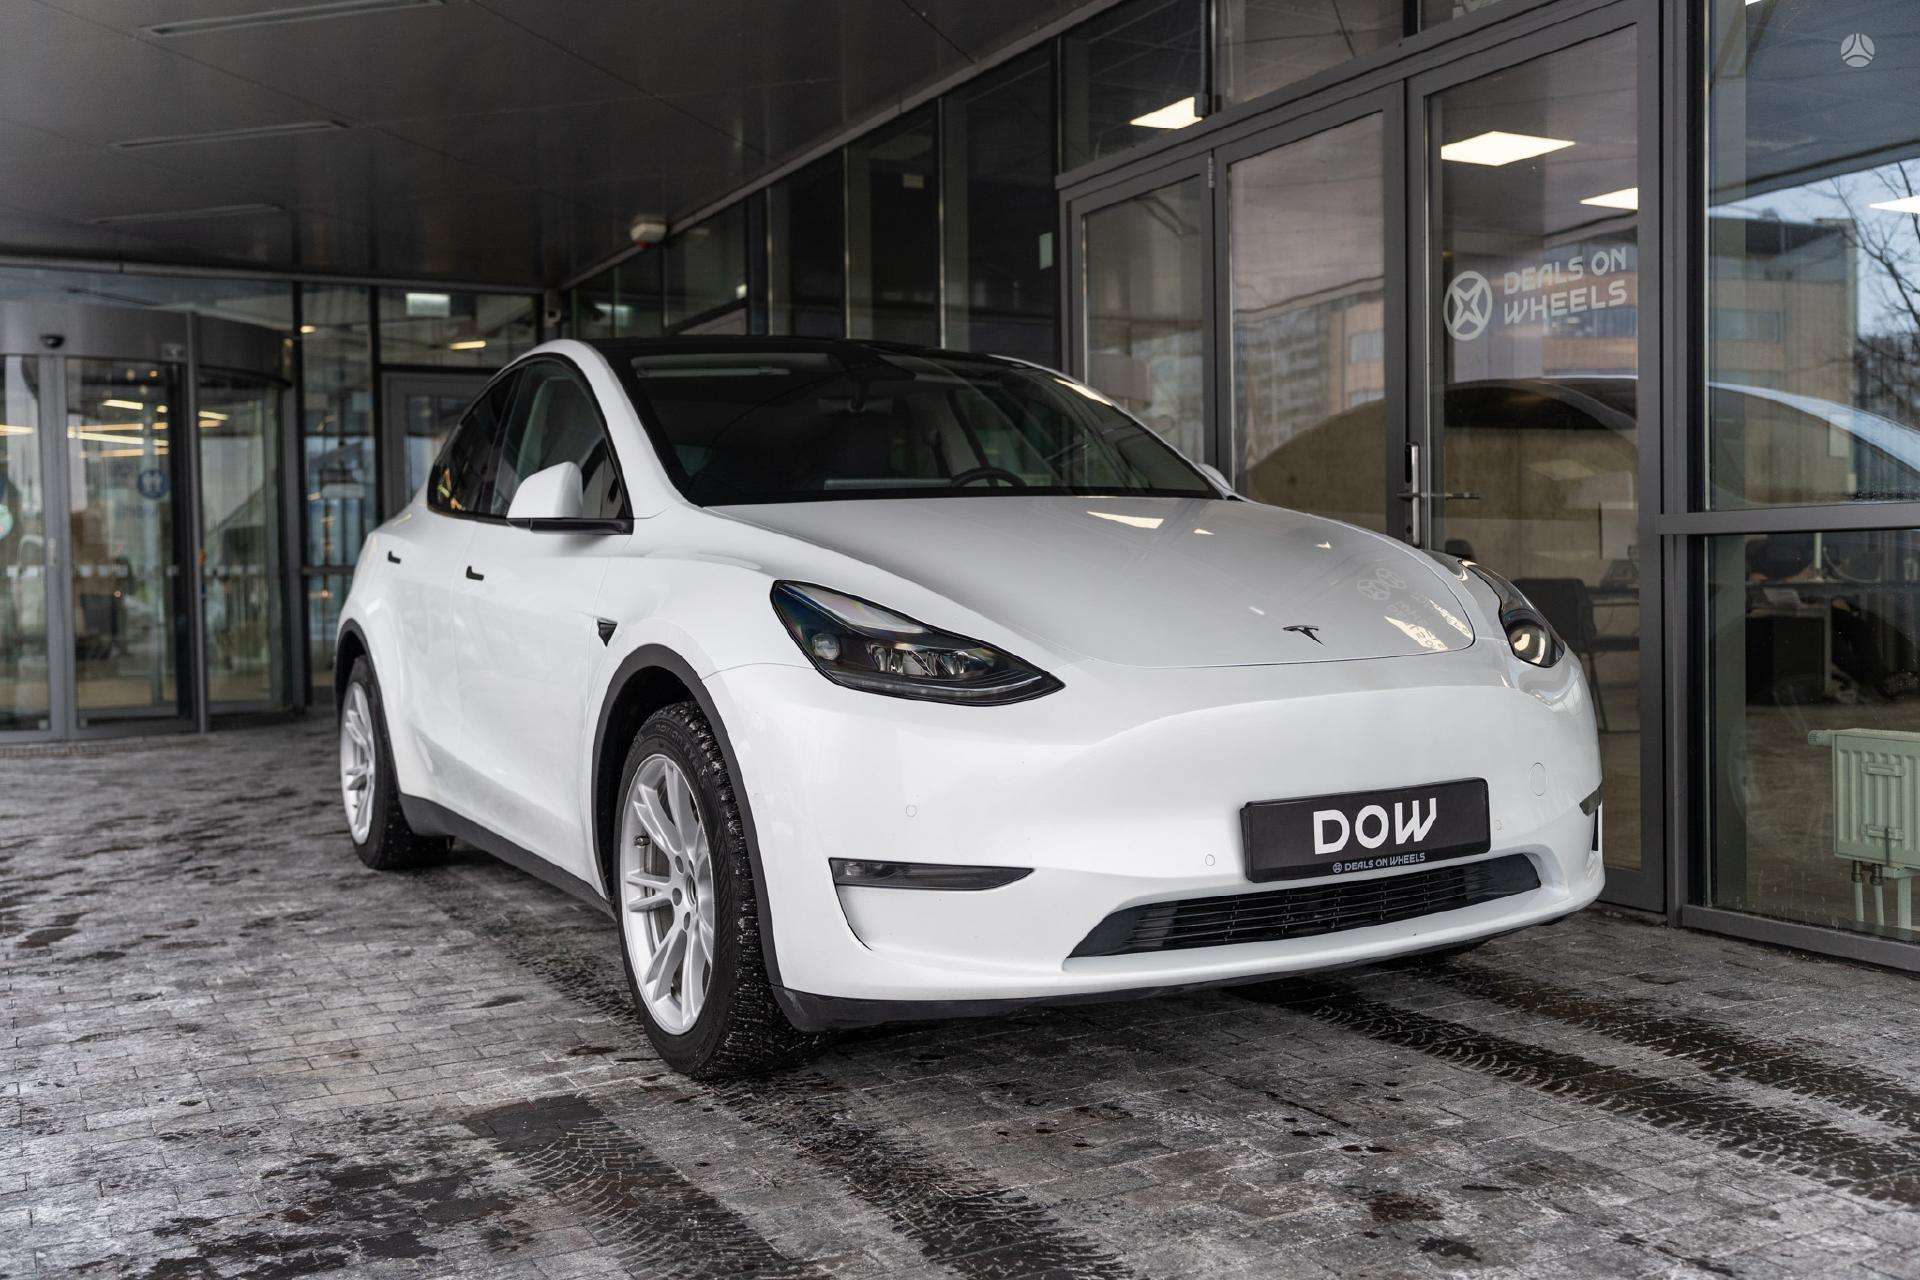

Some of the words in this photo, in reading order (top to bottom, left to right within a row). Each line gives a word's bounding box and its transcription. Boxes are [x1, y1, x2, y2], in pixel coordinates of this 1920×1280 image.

[1503, 256, 1583, 295] DEALS
[1591, 247, 1627, 276] ON
[1503, 279, 1628, 325] WHEELS
[1313, 797, 1437, 855] DOW
[1344, 860, 1374, 872] DEALS
[1375, 857, 1388, 867] ON
[1389, 852, 1426, 866] WHEELS
